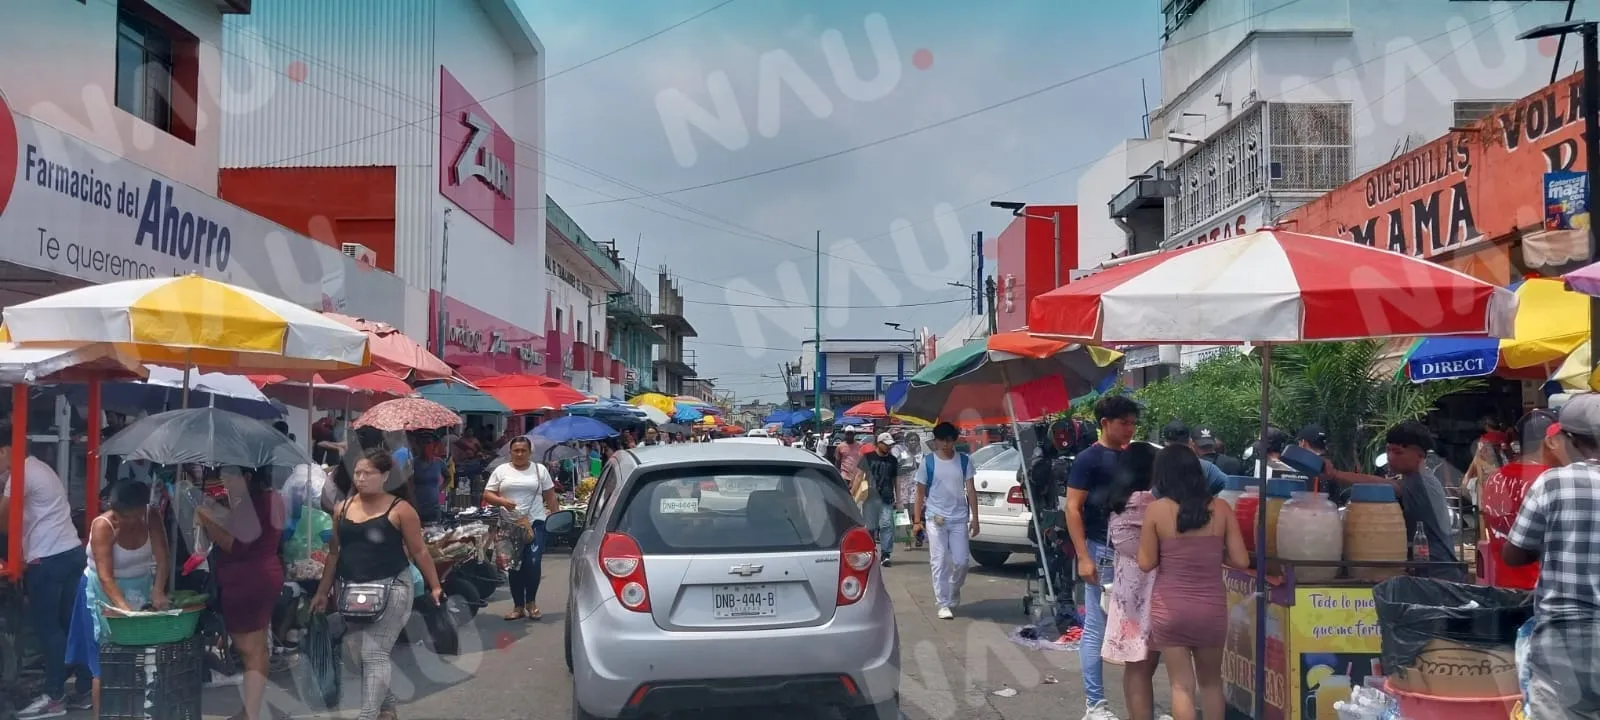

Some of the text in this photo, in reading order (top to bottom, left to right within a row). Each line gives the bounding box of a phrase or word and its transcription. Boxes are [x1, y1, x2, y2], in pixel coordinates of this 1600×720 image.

[25, 144, 231, 272] Farmacias del Ahorro
[37, 227, 60, 260] Te
[66, 242, 156, 280] queremos
[1421, 357, 1485, 376] DIRECT
[715, 592, 775, 609] DNB-444-B
[1308, 593, 1338, 609] Todo
[1341, 592, 1351, 609] lo
[1312, 624, 1334, 640] que
